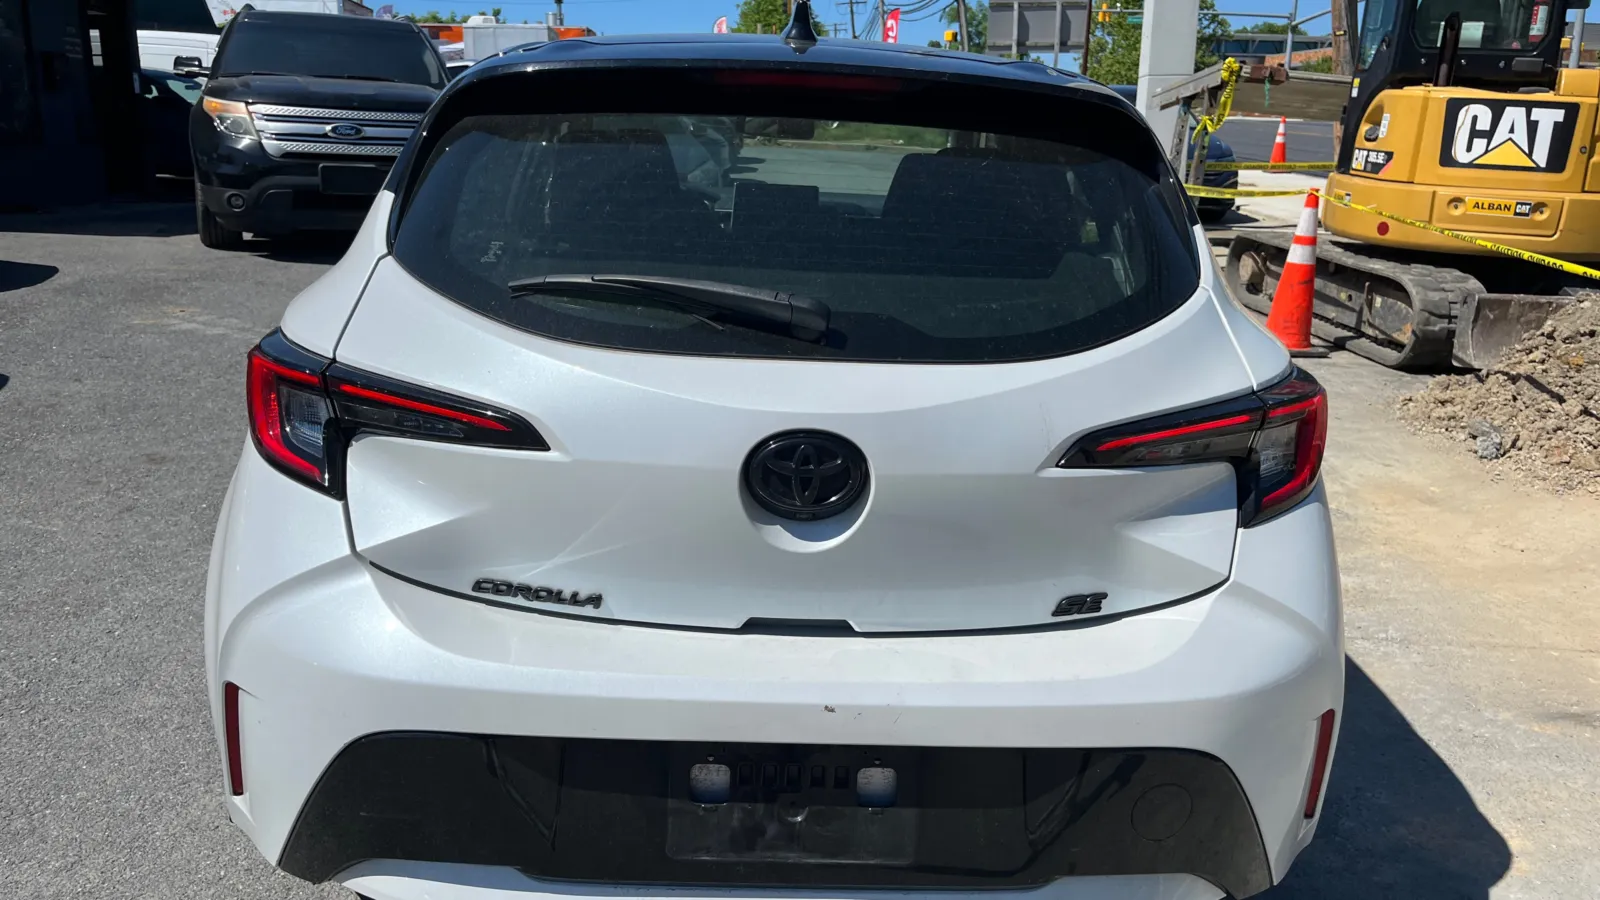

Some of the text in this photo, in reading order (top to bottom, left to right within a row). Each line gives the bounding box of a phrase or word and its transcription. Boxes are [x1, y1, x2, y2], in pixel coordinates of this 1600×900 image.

[336, 126, 356, 135] Ford
[1451, 103, 1566, 168] CAT
[1352, 149, 1368, 170] CAT
[1472, 202, 1531, 214] ALBAN CAT
[1490, 244, 1525, 259] CAUTION
[471, 578, 603, 609] COROLLA
[1051, 592, 1108, 617] SE
